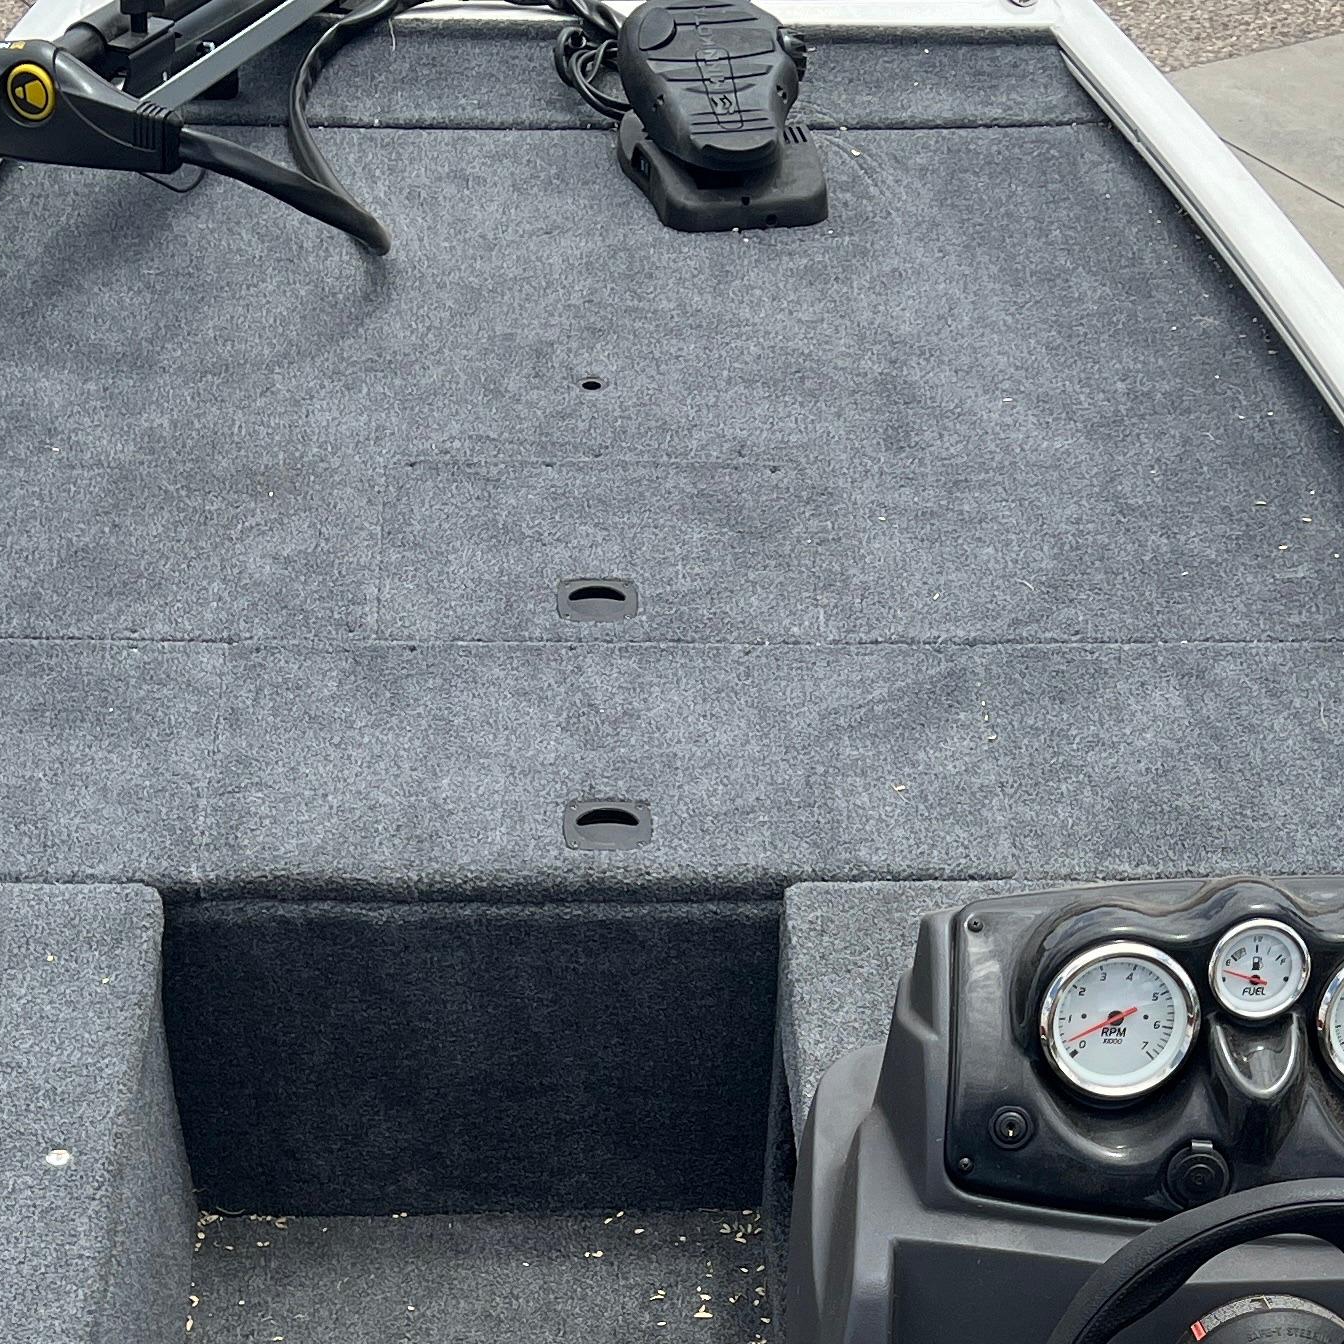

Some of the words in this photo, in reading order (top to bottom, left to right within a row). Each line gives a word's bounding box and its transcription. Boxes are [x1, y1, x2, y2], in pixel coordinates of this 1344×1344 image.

[1225, 958, 1231, 967] E
[1099, 972, 1107, 982] 3
[1125, 973, 1134, 982] 4
[1078, 987, 1086, 996] 2
[1241, 986, 1266, 996] FUEL
[1151, 992, 1159, 1002] 5
[1068, 1014, 1073, 1024] 1
[1153, 1020, 1161, 1030] 6
[1100, 1027, 1126, 1038] RPM
[1078, 1040, 1087, 1049] 0
[1141, 1041, 1149, 1050] 7
